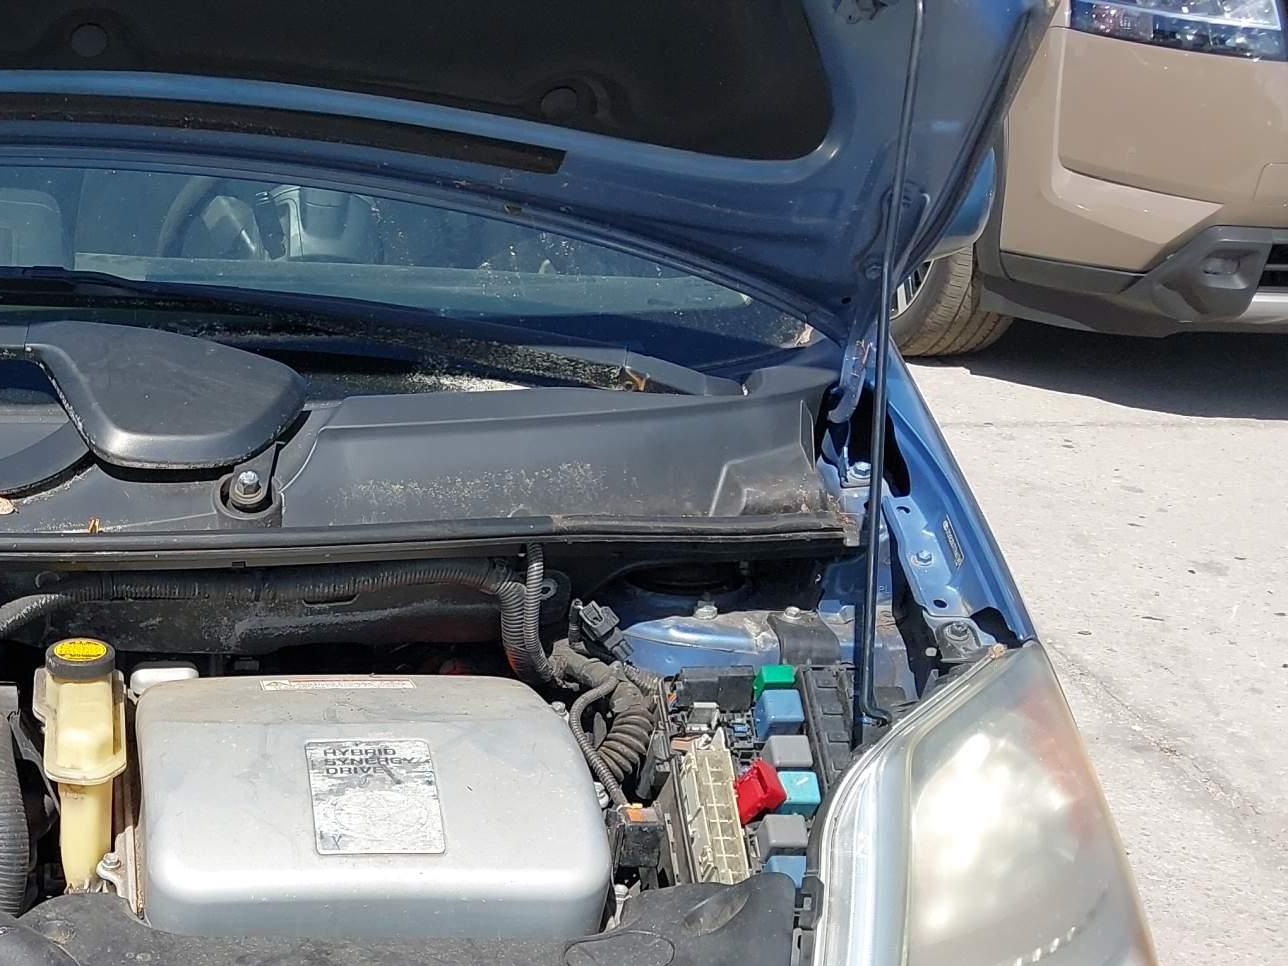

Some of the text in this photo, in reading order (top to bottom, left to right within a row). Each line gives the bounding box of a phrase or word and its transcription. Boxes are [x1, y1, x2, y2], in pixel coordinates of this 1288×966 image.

[323, 748, 397, 757] HYBRID
[324, 757, 415, 766] SYNERGY
[325, 766, 386, 775] DRIVE
